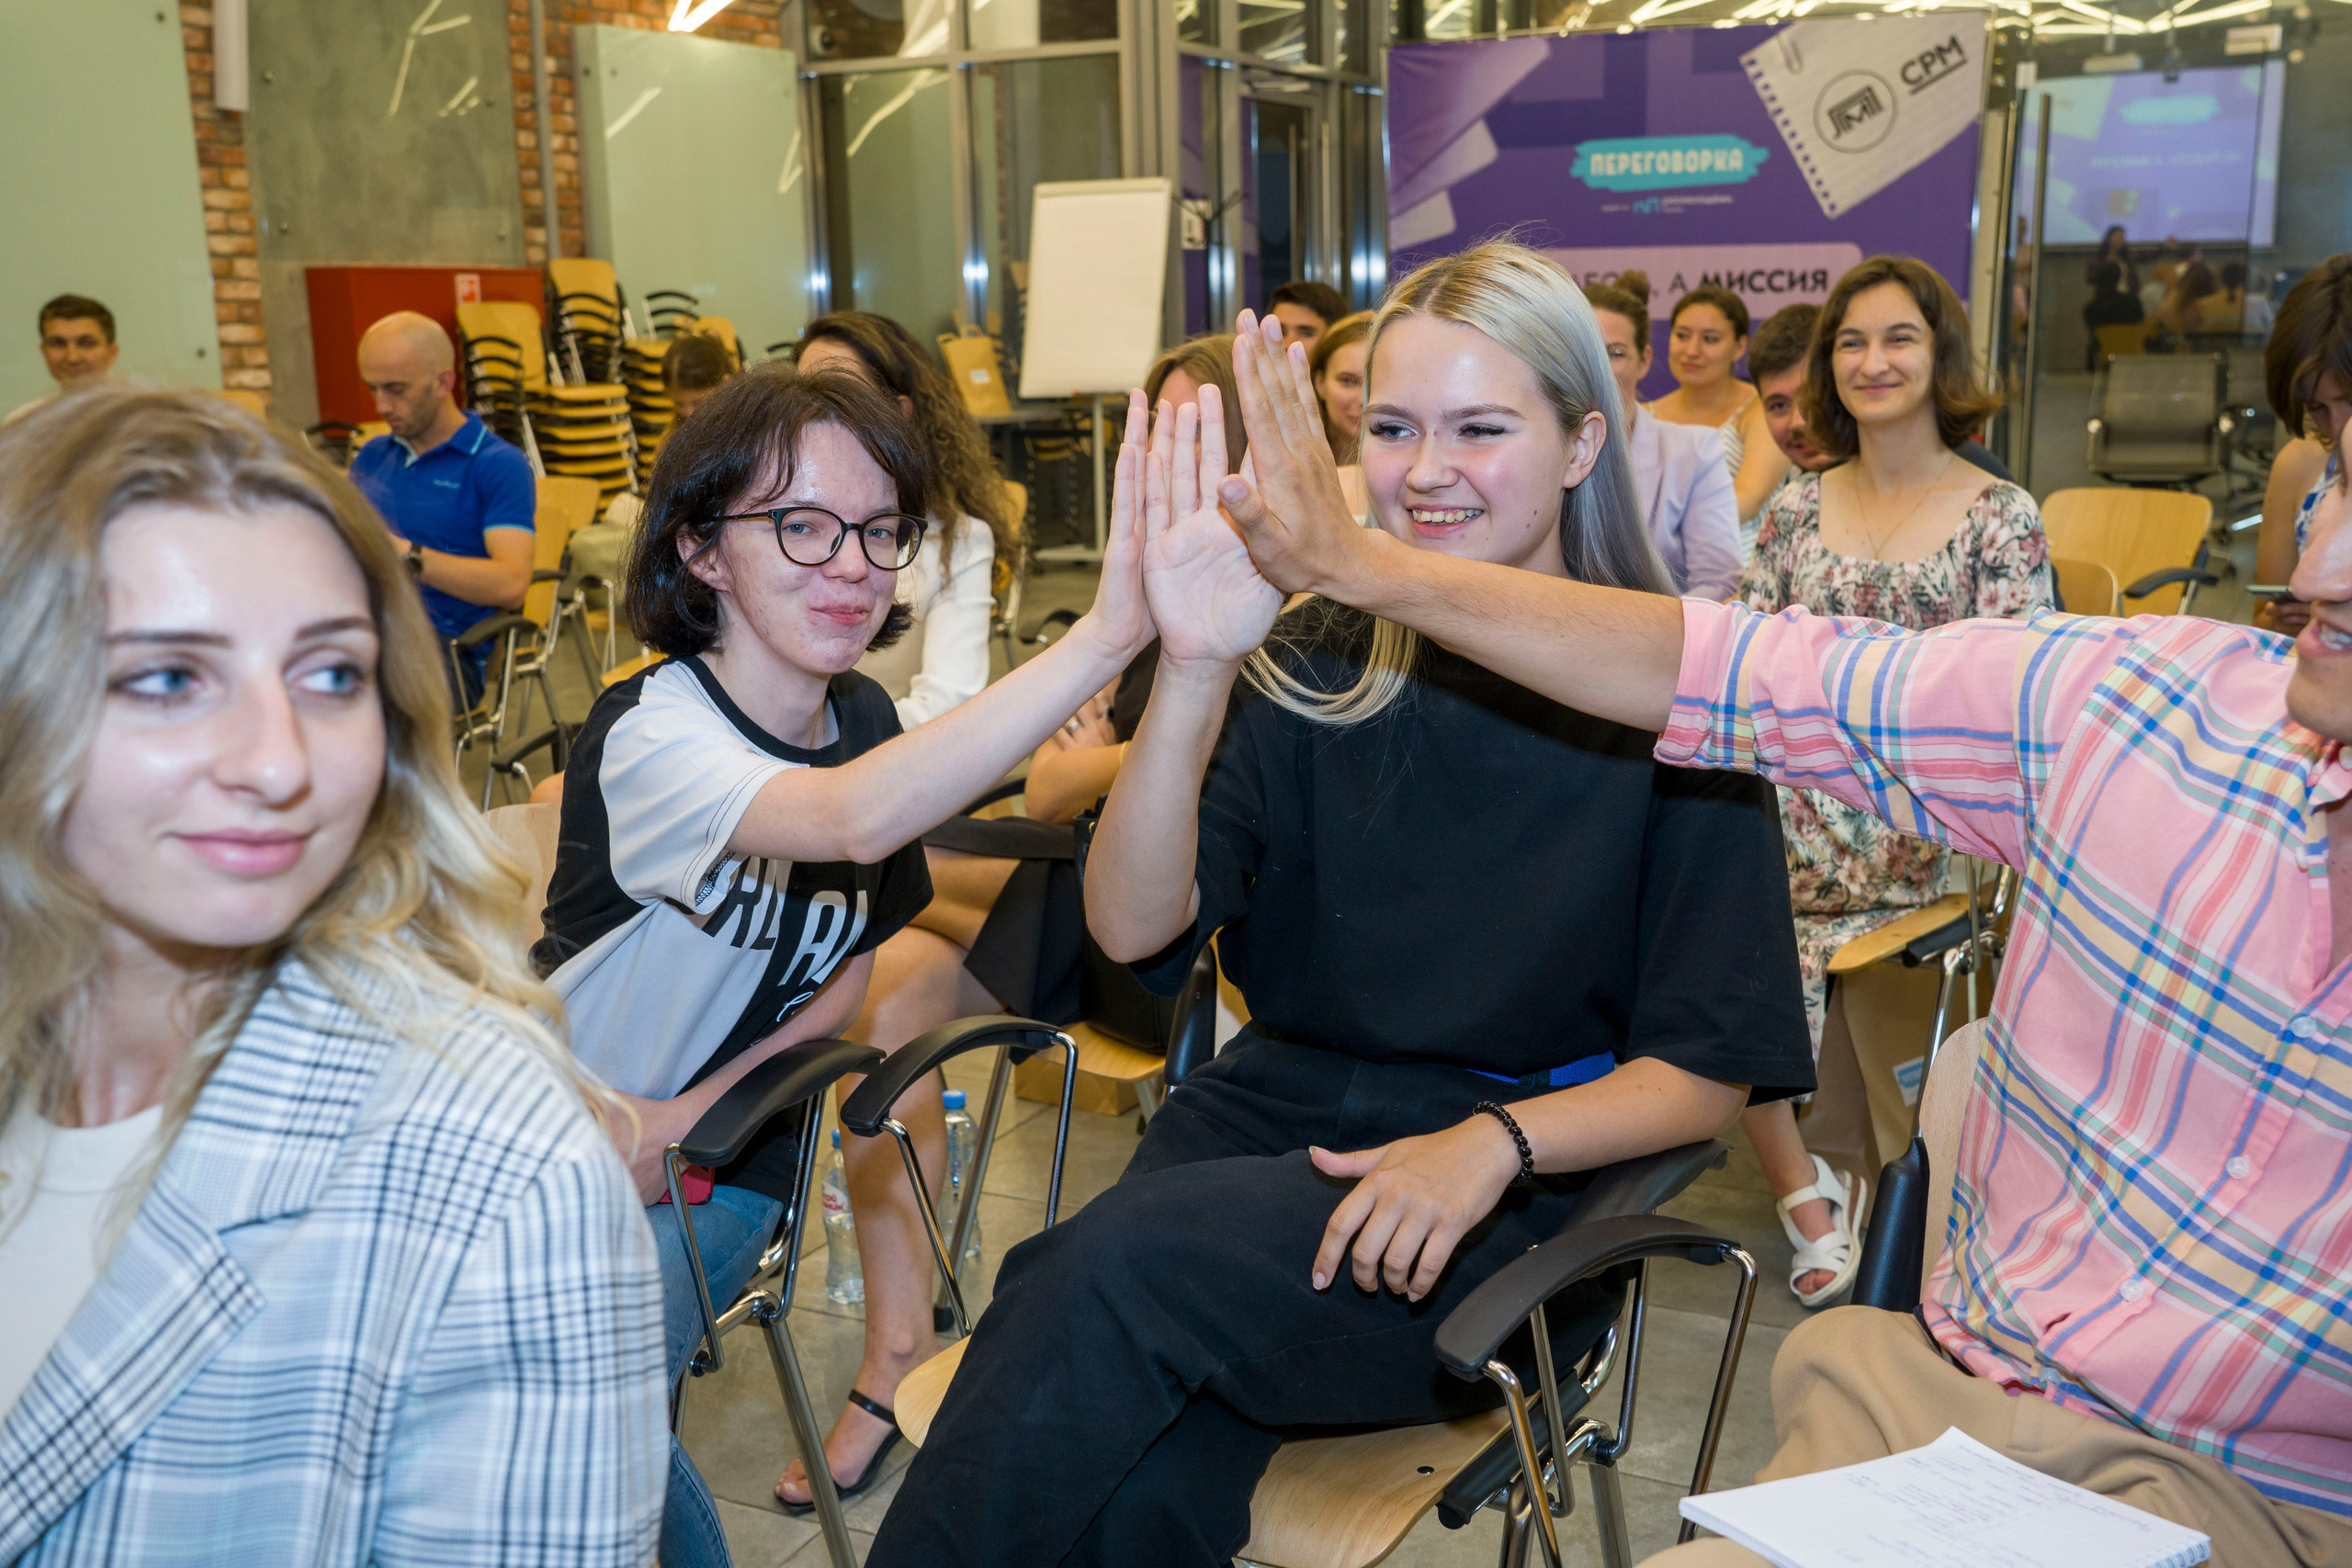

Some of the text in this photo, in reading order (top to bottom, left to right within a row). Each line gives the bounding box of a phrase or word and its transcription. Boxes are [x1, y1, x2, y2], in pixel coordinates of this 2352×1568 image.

[1899, 34, 1964, 85] СРМ
[1589, 148, 1744, 176] ПЕРЕГОВОРКА
[1668, 272, 1689, 294] А
[1700, 269, 1828, 293] МИССИЯ
